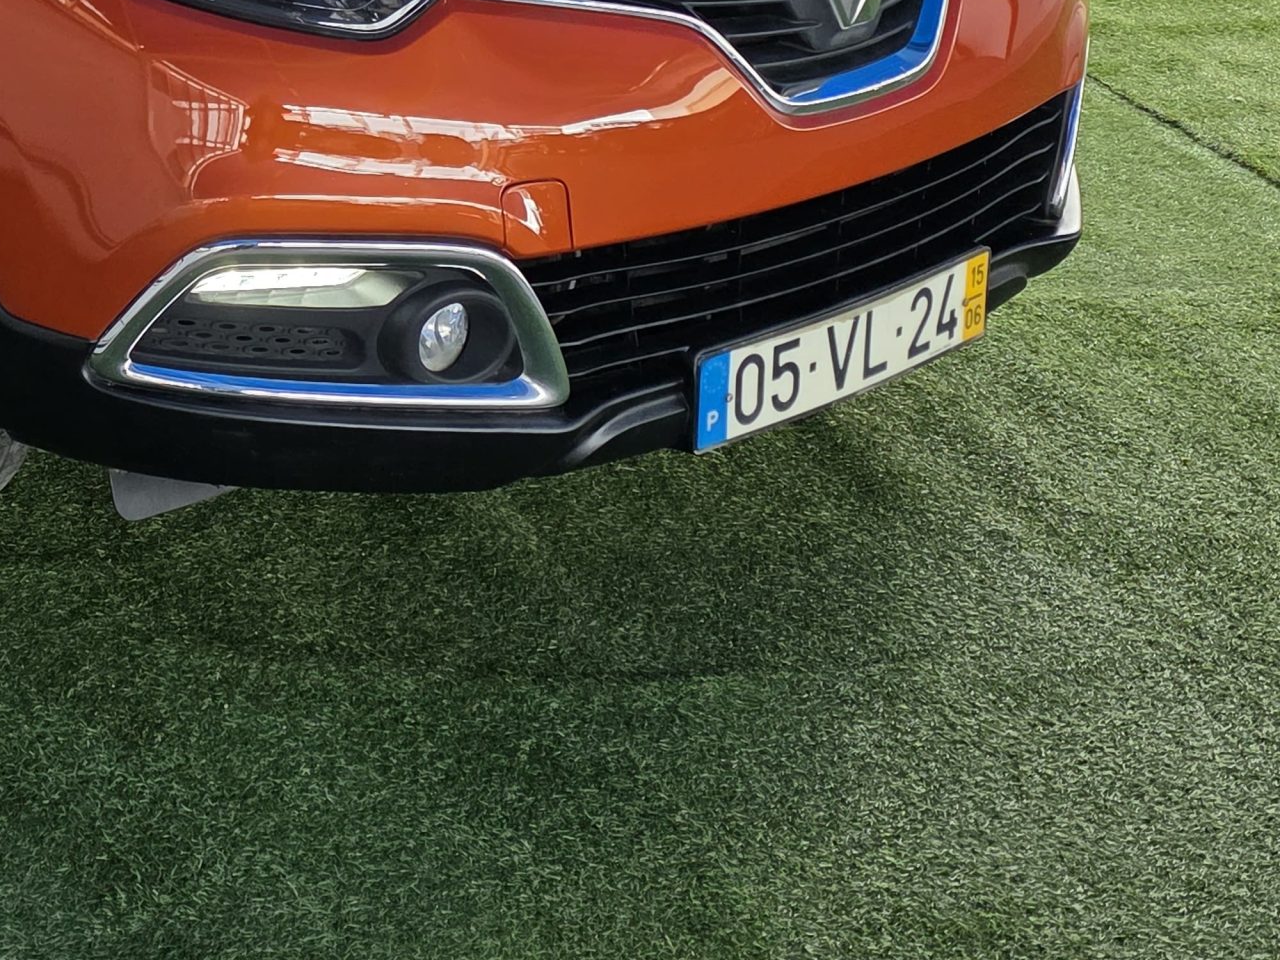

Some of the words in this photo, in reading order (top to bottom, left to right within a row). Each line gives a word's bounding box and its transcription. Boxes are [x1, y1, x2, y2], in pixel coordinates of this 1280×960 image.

[970, 263, 985, 288] 15
[965, 305, 982, 330] 06
[706, 410, 719, 432] P
